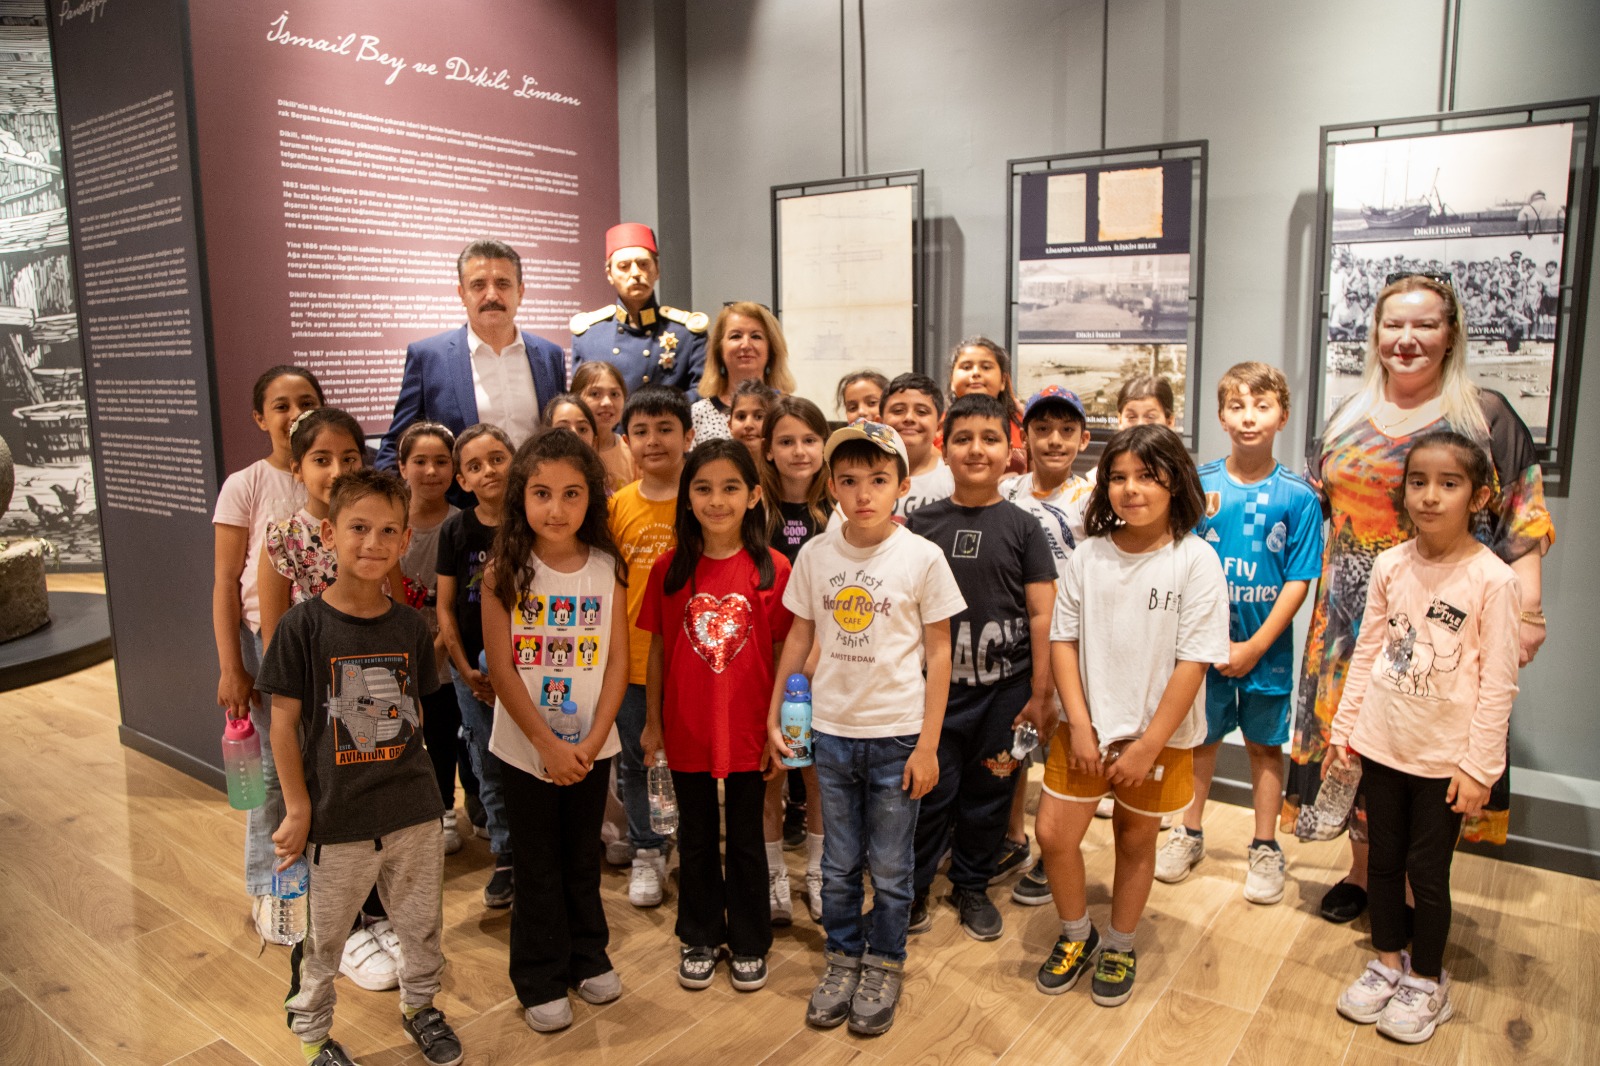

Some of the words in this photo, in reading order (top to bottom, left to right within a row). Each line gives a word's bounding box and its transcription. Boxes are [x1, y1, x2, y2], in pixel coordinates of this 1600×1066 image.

[266, 10, 357, 55] İsmail
[356, 35, 407, 86] Bey
[412, 62, 439, 75] ve
[445, 57, 511, 91] Dikili
[513, 75, 581, 106] Limanı
[290, 112, 319, 123] Bergama
[280, 141, 309, 149] kurumun
[280, 151, 318, 162] telgrafhane
[300, 182, 319, 190] tarihli
[1413, 227, 1439, 236] DİKİLİ
[1440, 226, 1471, 234] LİMANI
[1137, 242, 1157, 250] BELGE
[287, 251, 300, 259] Ağa
[783, 525, 807, 537] GOOD
[788, 537, 801, 545] DAY
[1224, 557, 1257, 581] Fly
[829, 571, 846, 587] my
[855, 570, 883, 591] first
[1228, 581, 1278, 602] irates
[823, 594, 853, 611] Hard
[854, 596, 892, 616] Rock
[843, 617, 862, 625] CAFE
[835, 631, 870, 648] t-shirt
[830, 652, 876, 663] AMSTERDAM
[339, 748, 386, 763] AVIATION
